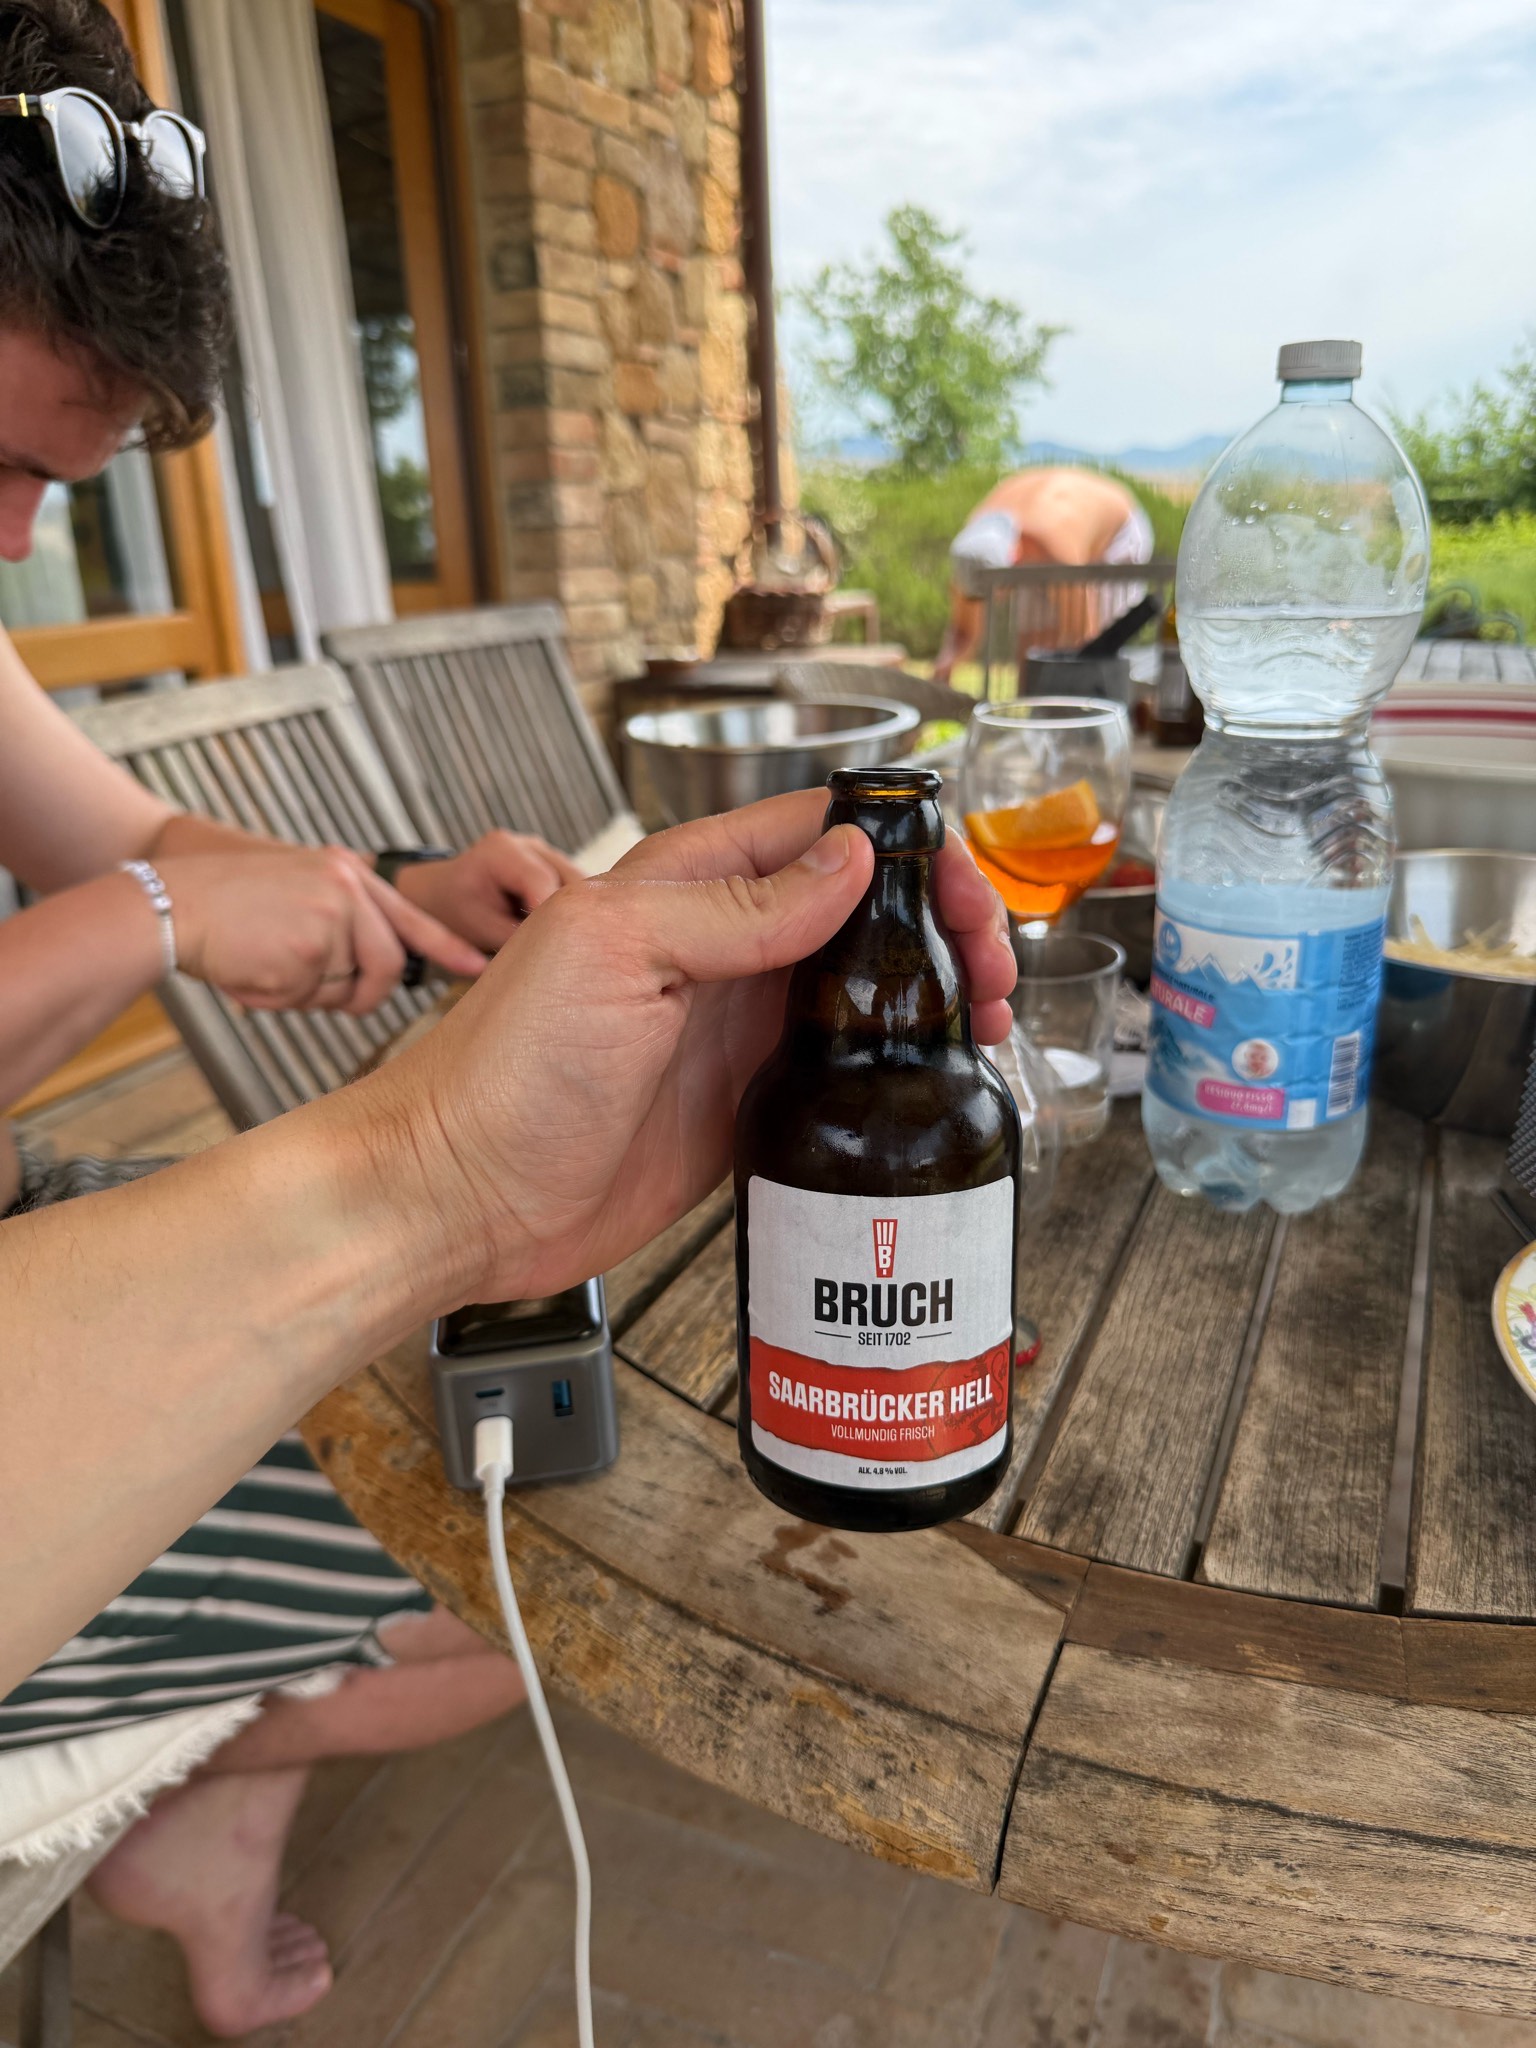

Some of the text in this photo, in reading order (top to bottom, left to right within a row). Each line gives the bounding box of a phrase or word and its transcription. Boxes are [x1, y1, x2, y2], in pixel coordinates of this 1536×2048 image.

[1151, 980, 1208, 1025] TURALE
[814, 1277, 953, 1327] BRUCH
[858, 1331, 911, 1346] SEIT 1702
[769, 1371, 993, 1422] SAARBRÜCKER HELL
[831, 1424, 935, 1441] VOLLMUNDIG FRISCH
[858, 1466, 872, 1474] ALK.
